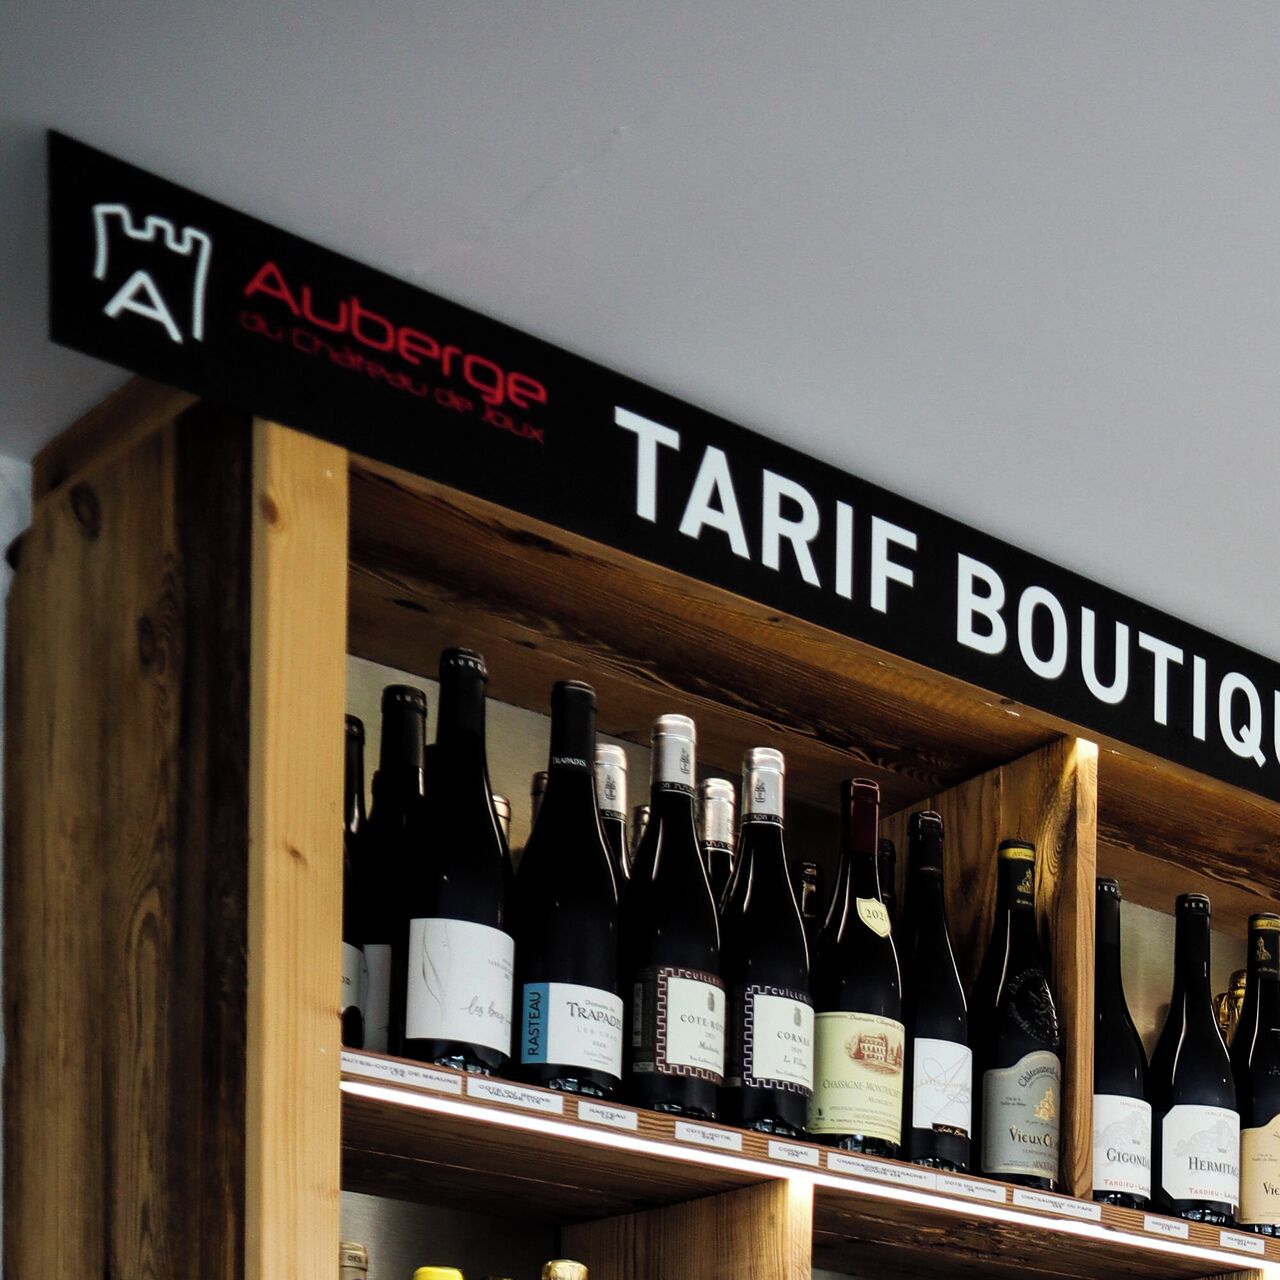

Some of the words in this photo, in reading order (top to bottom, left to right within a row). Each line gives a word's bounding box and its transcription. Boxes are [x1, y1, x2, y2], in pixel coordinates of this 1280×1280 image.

[244, 261, 547, 409] Auberge
[433, 386, 474, 414] de
[613, 405, 918, 615] TARIF
[527, 991, 542, 1056] RASTEAU
